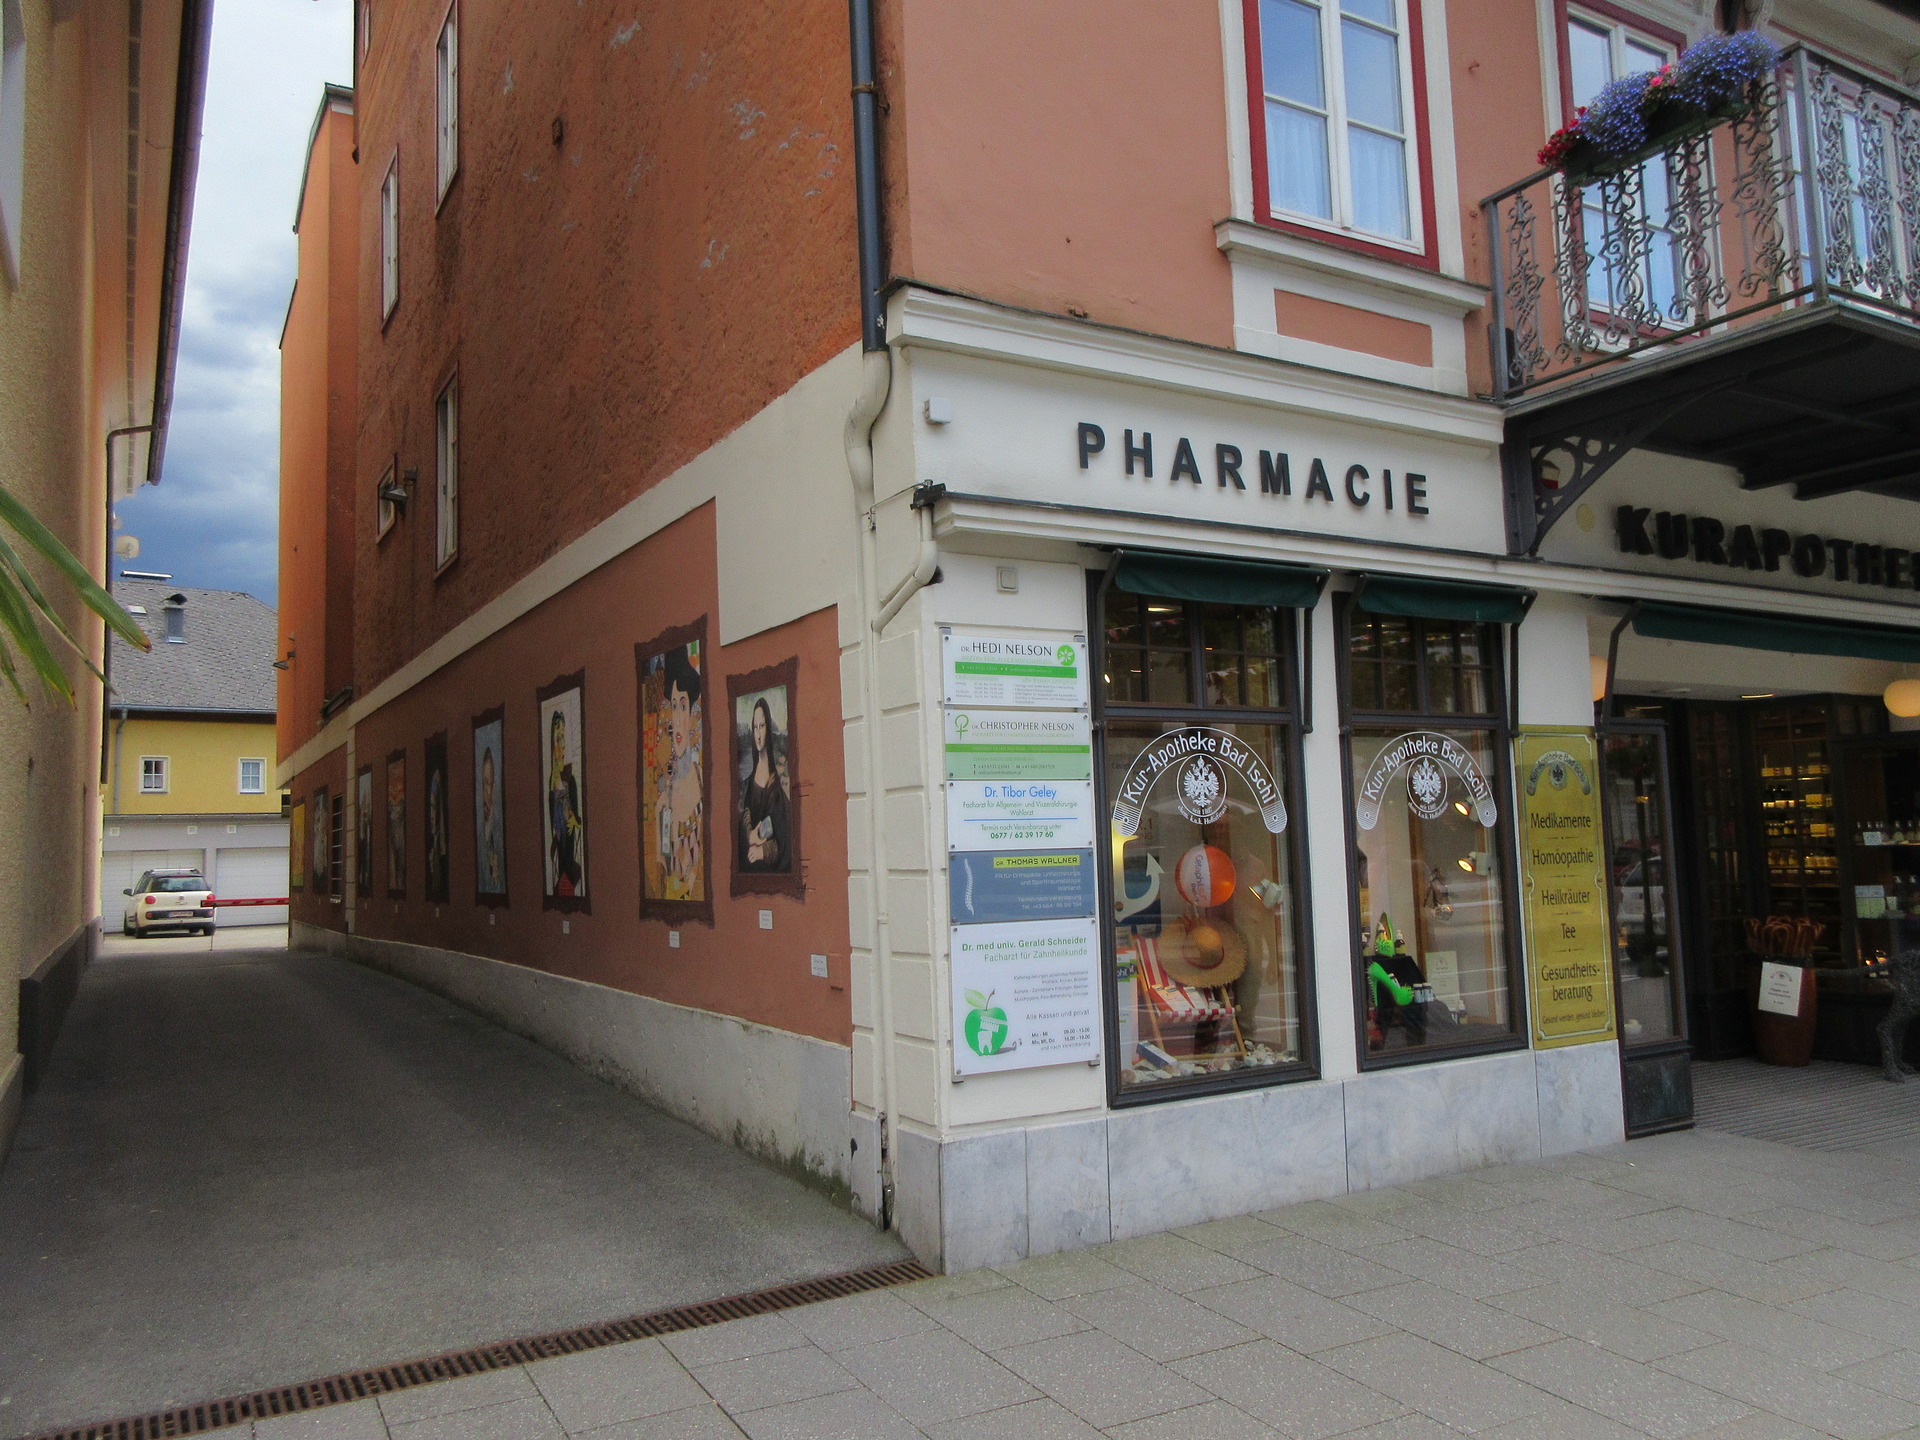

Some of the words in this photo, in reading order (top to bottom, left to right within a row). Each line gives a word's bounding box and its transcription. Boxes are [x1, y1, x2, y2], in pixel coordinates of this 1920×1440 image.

[1078, 422, 1429, 515] PHARMACIE
[1616, 504, 1920, 592] KURAPOTHE
[972, 642, 1000, 654] HEDI
[1006, 644, 1052, 656] NELSON
[980, 721, 1038, 730] CHRISTOPHER
[1042, 722, 1074, 731] NELSON
[1124, 731, 1216, 804] Kur-Apotheke
[1219, 736, 1249, 768] Bad
[1246, 760, 1277, 804] Ischl
[1365, 736, 1438, 801] Kur-Apotheke
[1440, 740, 1465, 768] Bad
[1463, 762, 1488, 801] Ischl
[984, 786, 998, 798] Dr.
[1002, 785, 1026, 798] Tibor
[1029, 786, 1056, 800] Geley
[1531, 813, 1591, 828] Medikamente
[1533, 847, 1594, 868] Homöopathie
[1542, 889, 1591, 906] Heilkräuter
[1561, 923, 1576, 939] Tee
[1018, 939, 1045, 947] Gerald
[1048, 937, 1087, 946] Schneider
[984, 952, 1018, 962] Facharzt
[1020, 951, 1030, 959] für
[1033, 948, 1088, 959] Zahnheilkunde
[1542, 963, 1600, 981] Gesundheits-
[1552, 985, 1592, 1001] beratung
